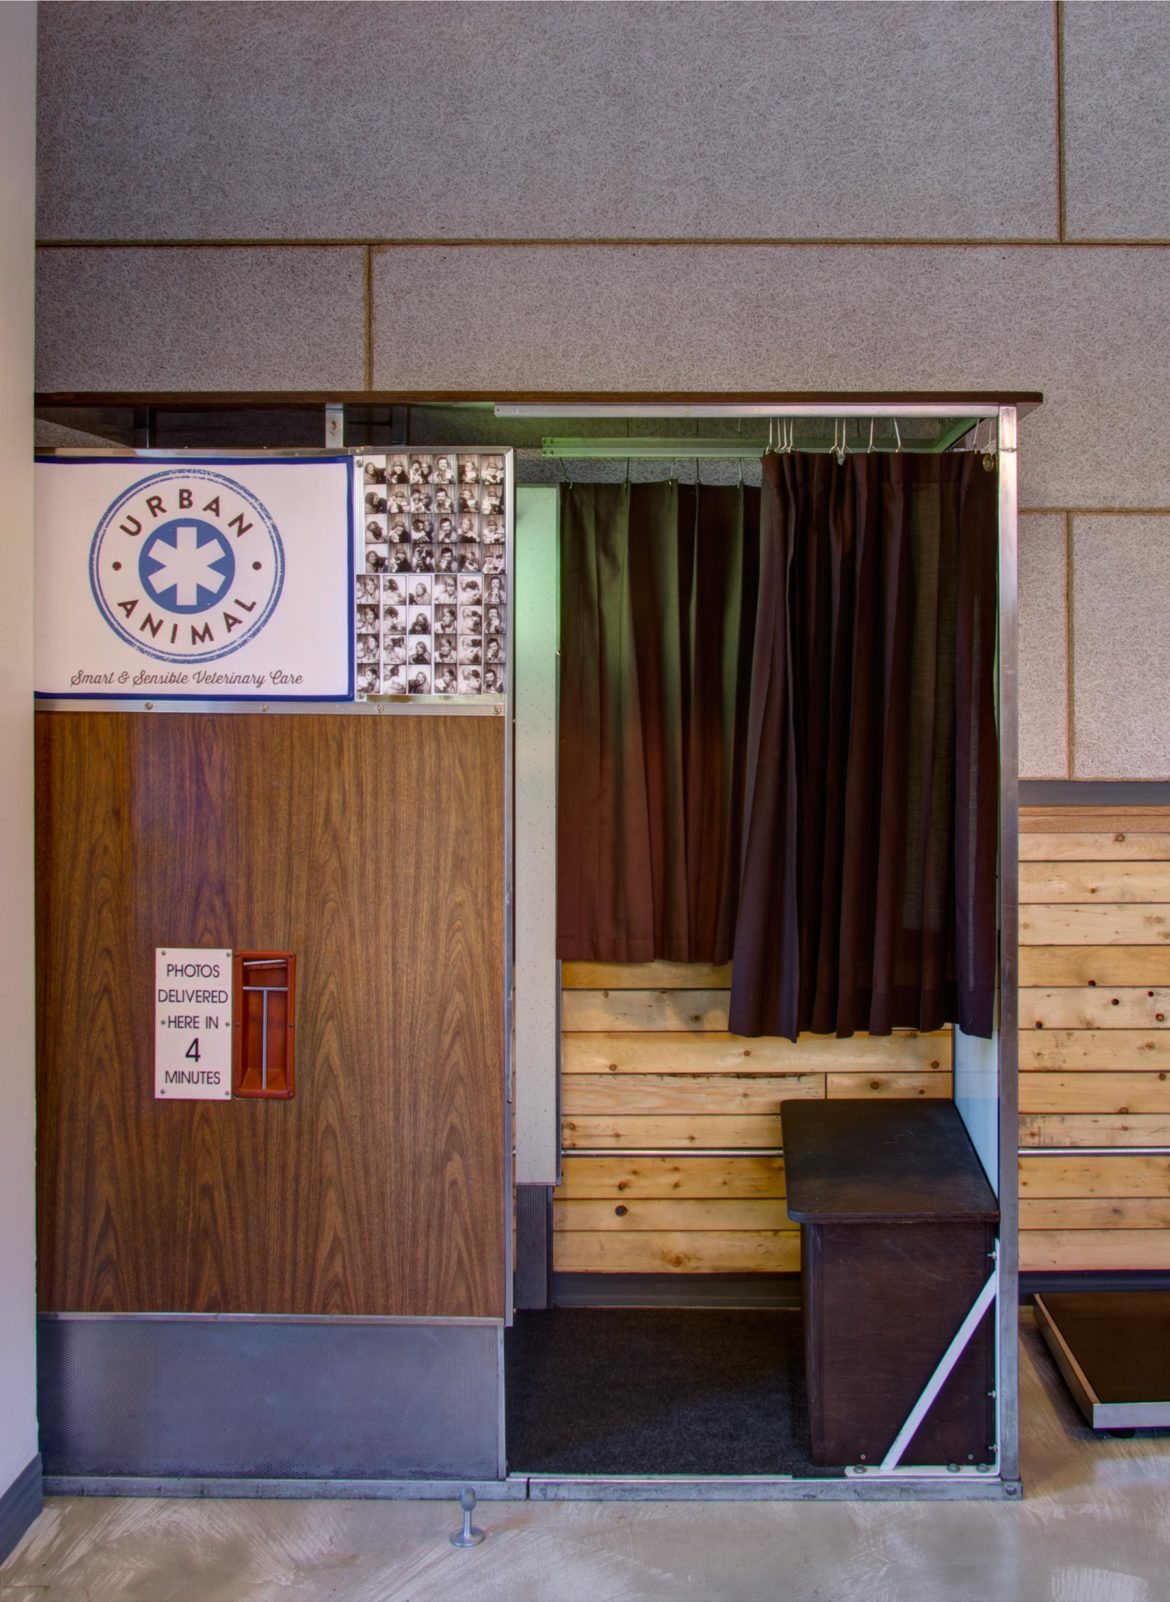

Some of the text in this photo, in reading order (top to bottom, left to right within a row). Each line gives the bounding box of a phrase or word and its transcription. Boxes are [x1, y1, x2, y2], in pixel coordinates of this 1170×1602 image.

[119, 488, 254, 538] URBAN
[117, 598, 257, 646] ANIMAL
[70, 669, 304, 689] Smart & Sensible Veterinary Care
[166, 963, 220, 978] PHOTOS
[158, 989, 229, 1004] DELIVERED
[167, 1015, 219, 1029] HERE IN
[185, 1037, 201, 1062] 4
[165, 1070, 221, 1085] MINUTES
